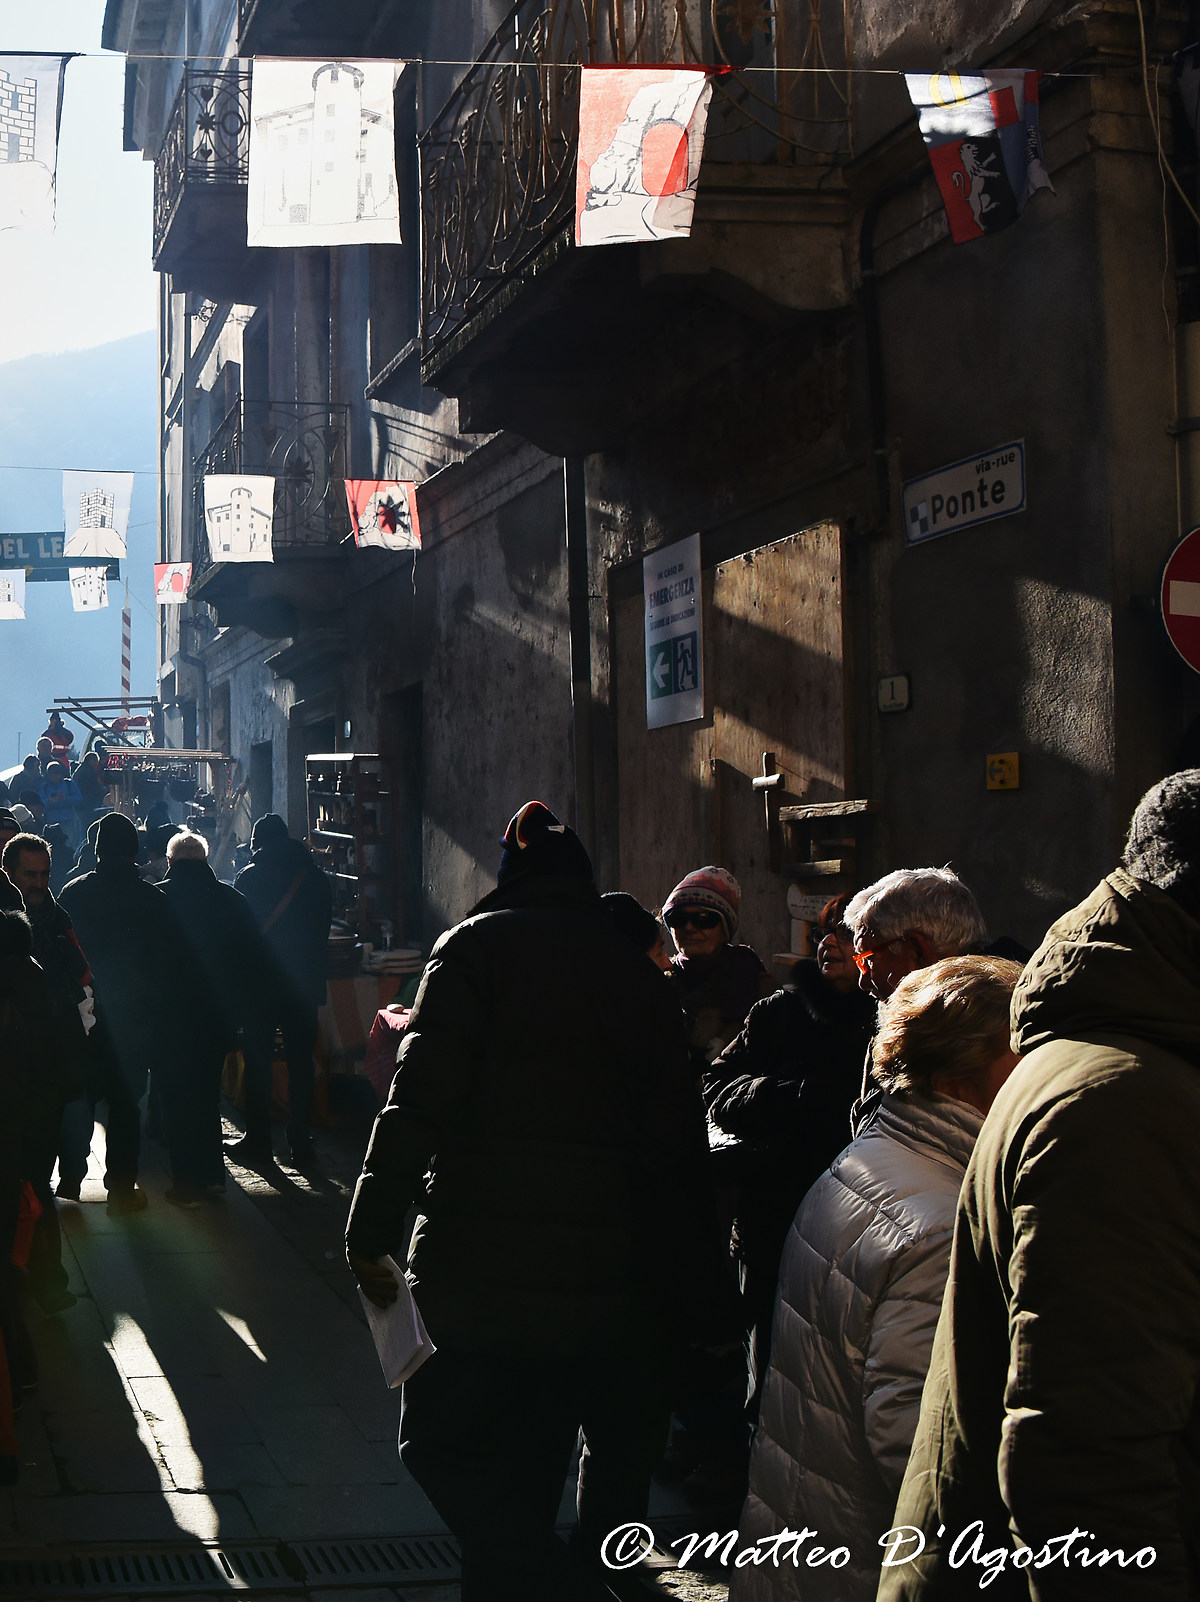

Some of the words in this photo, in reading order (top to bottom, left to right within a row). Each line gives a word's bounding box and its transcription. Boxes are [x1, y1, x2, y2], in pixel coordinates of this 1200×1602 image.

[975, 452, 1015, 474] via-rue
[931, 478, 1006, 524] Ponte
[38, 536, 64, 558] LE
[649, 576, 695, 609] EMERGENZA
